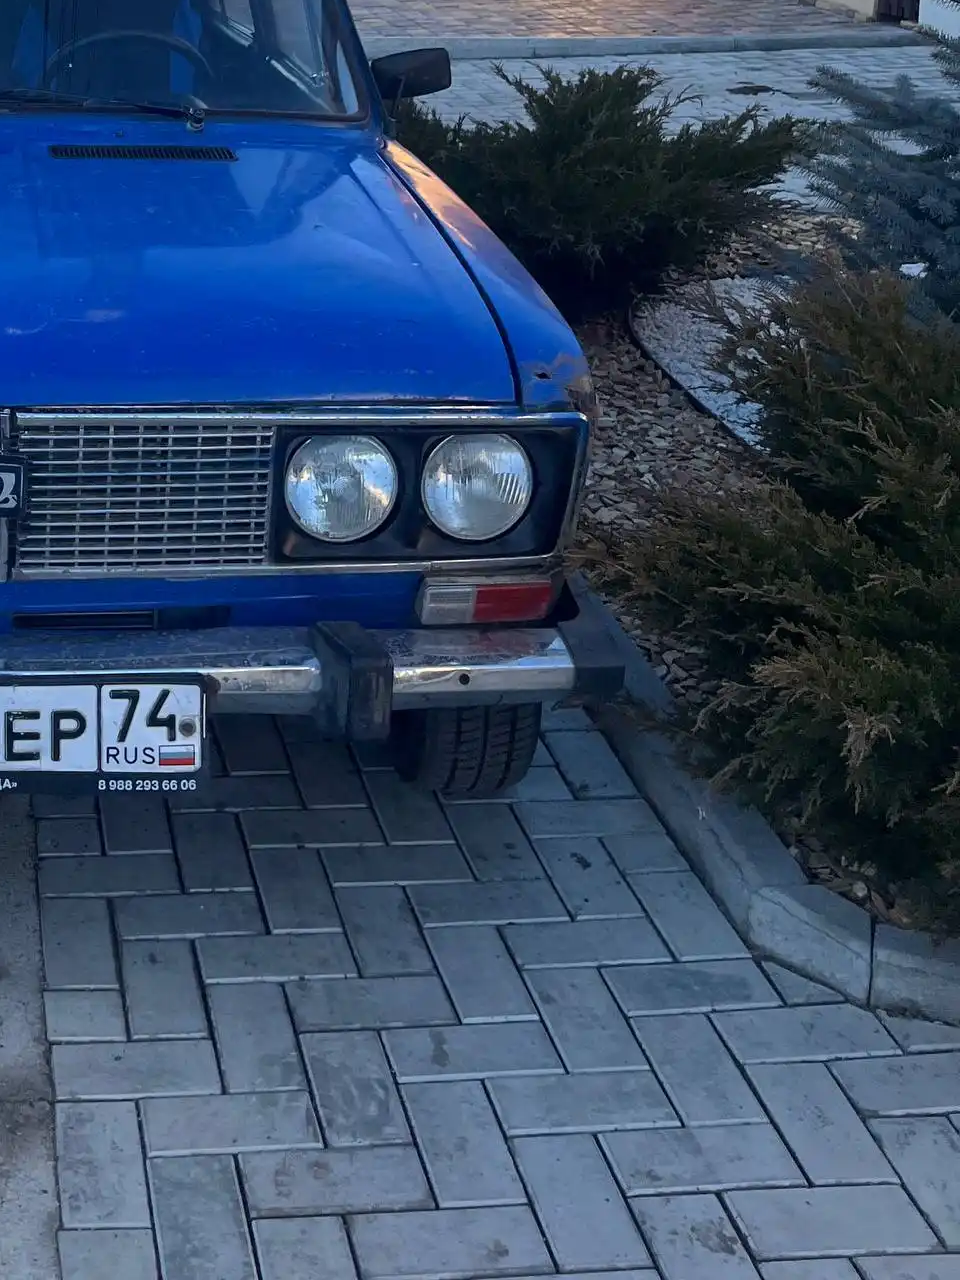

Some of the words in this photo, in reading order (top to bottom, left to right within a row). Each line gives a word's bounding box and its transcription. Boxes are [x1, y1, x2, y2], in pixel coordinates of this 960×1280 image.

[109, 688, 177, 743] 74
[105, 746, 156, 766] RUS
[98, 780, 106, 790] 8
[109, 780, 133, 790] 988
[135, 780, 159, 790] 293
[162, 780, 178, 790] 66
[180, 779, 197, 790] 06
